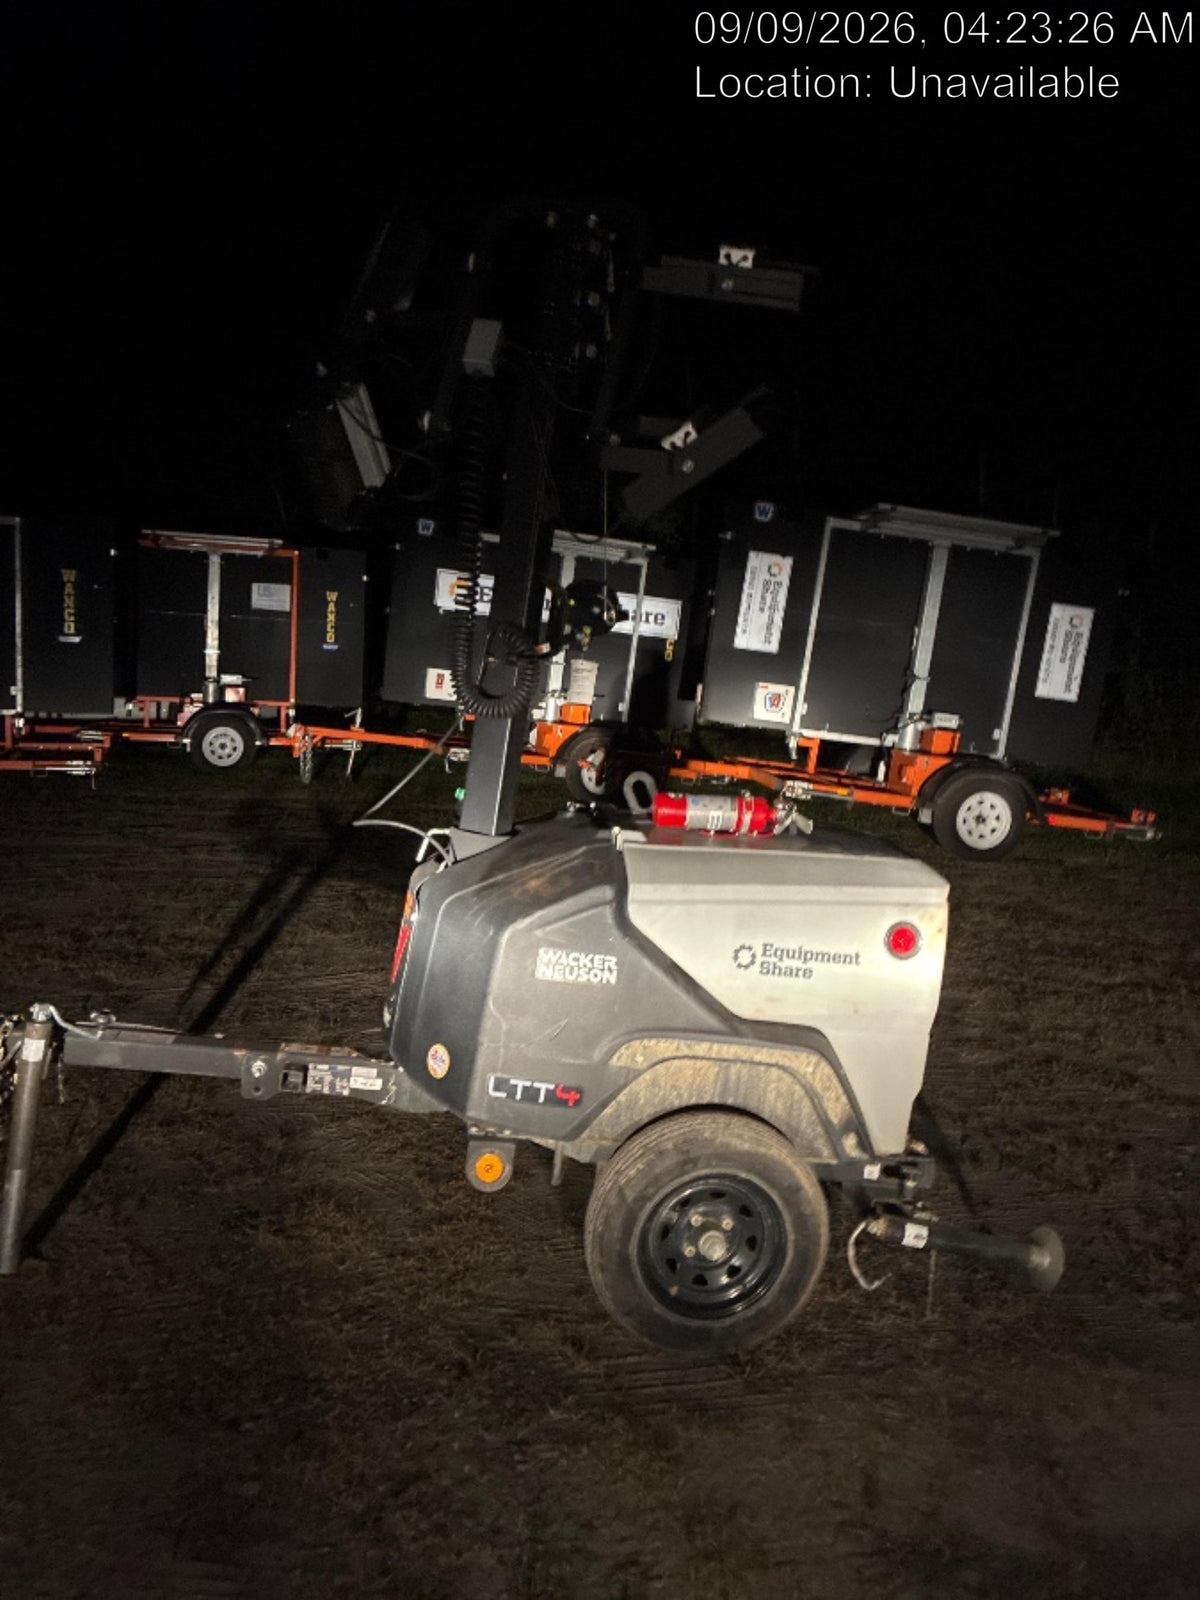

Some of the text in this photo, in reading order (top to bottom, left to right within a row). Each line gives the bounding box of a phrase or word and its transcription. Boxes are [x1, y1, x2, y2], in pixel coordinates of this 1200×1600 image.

[537, 947, 618, 969] WACKER
[761, 943, 861, 966] Equipment
[535, 963, 618, 985] NEUSON
[759, 960, 814, 979] Share
[487, 1074, 581, 1107] LTT4
